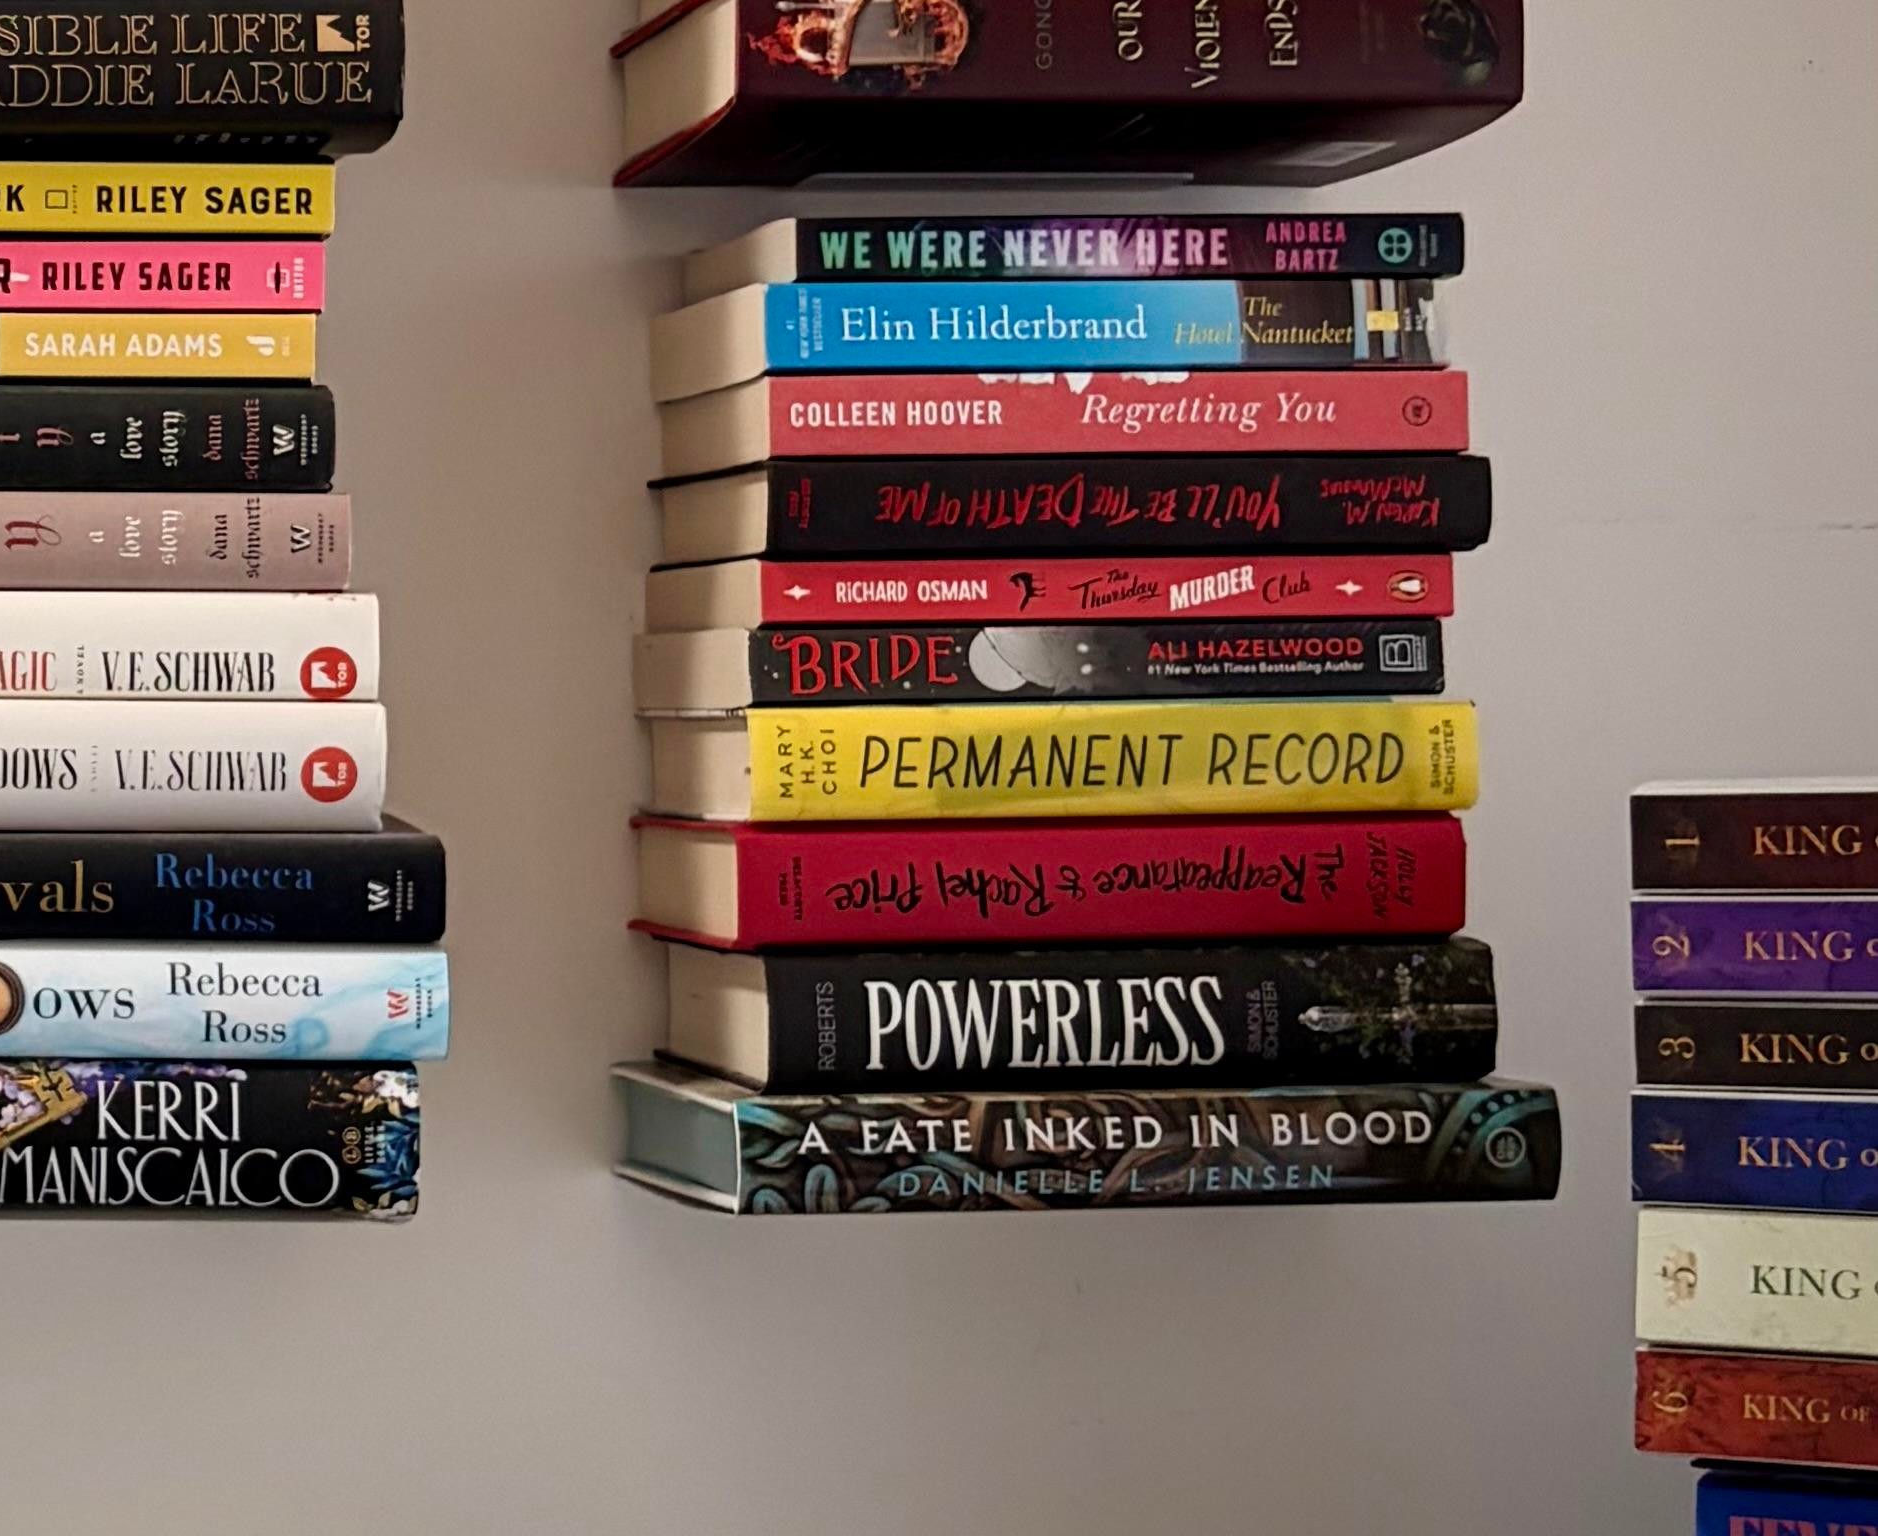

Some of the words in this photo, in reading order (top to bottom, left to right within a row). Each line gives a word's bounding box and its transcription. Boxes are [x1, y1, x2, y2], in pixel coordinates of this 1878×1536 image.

[356, 15, 371, 53] TOR
[96, 184, 187, 214] RILEY
[205, 185, 312, 216] SAGER
[1265, 222, 1346, 243] ANDREA
[820, 233, 872, 269] WE
[888, 231, 987, 268] WERE
[1003, 230, 1118, 266] NEVER
[1136, 230, 1228, 266] HERE
[1275, 248, 1338, 272] BARTZ
[841, 308, 915, 341] Elin
[930, 305, 1147, 341] Hilderbrand
[26, 333, 115, 357] SARAH
[126, 333, 222, 358] ADAMS
[790, 401, 896, 427] COLLEEN
[906, 401, 1002, 426] HOOVER
[771, 634, 957, 695] BRIDE
[1147, 641, 1187, 659] ALI
[1198, 638, 1363, 658] HAZELWOOD
[776, 725, 794, 798] MARY
[820, 729, 837, 795] CHOI
[862, 736, 1184, 788] PERMANENT
[1209, 733, 1402, 785] RECORD
[1665, 837, 1700, 847] 1
[1753, 825, 1863, 855] KING
[1652, 935, 1691, 957] 2
[1744, 931, 1854, 960] KING
[168, 963, 322, 998] Rebecca
[202, 1011, 286, 1045] Ross
[819, 981, 834, 1071] ROBERTS
[866, 975, 1225, 1070] POWERLESS
[1659, 1036, 1696, 1058] 3
[1739, 1034, 1849, 1064] KING
[798, 1121, 830, 1154] A
[854, 1119, 972, 1154] FATE
[1005, 1117, 1163, 1152] INKED
[1190, 1115, 1240, 1148] IN
[1271, 1111, 1432, 1146] BLOOD
[1737, 1137, 1847, 1168] KING
[898, 1168, 1105, 1197] DANIELLE
[1129, 1167, 1161, 1193] L.
[1186, 1165, 1336, 1191] JENSEN
[1750, 1264, 1860, 1298] KING
[1743, 1394, 1831, 1423] KING
